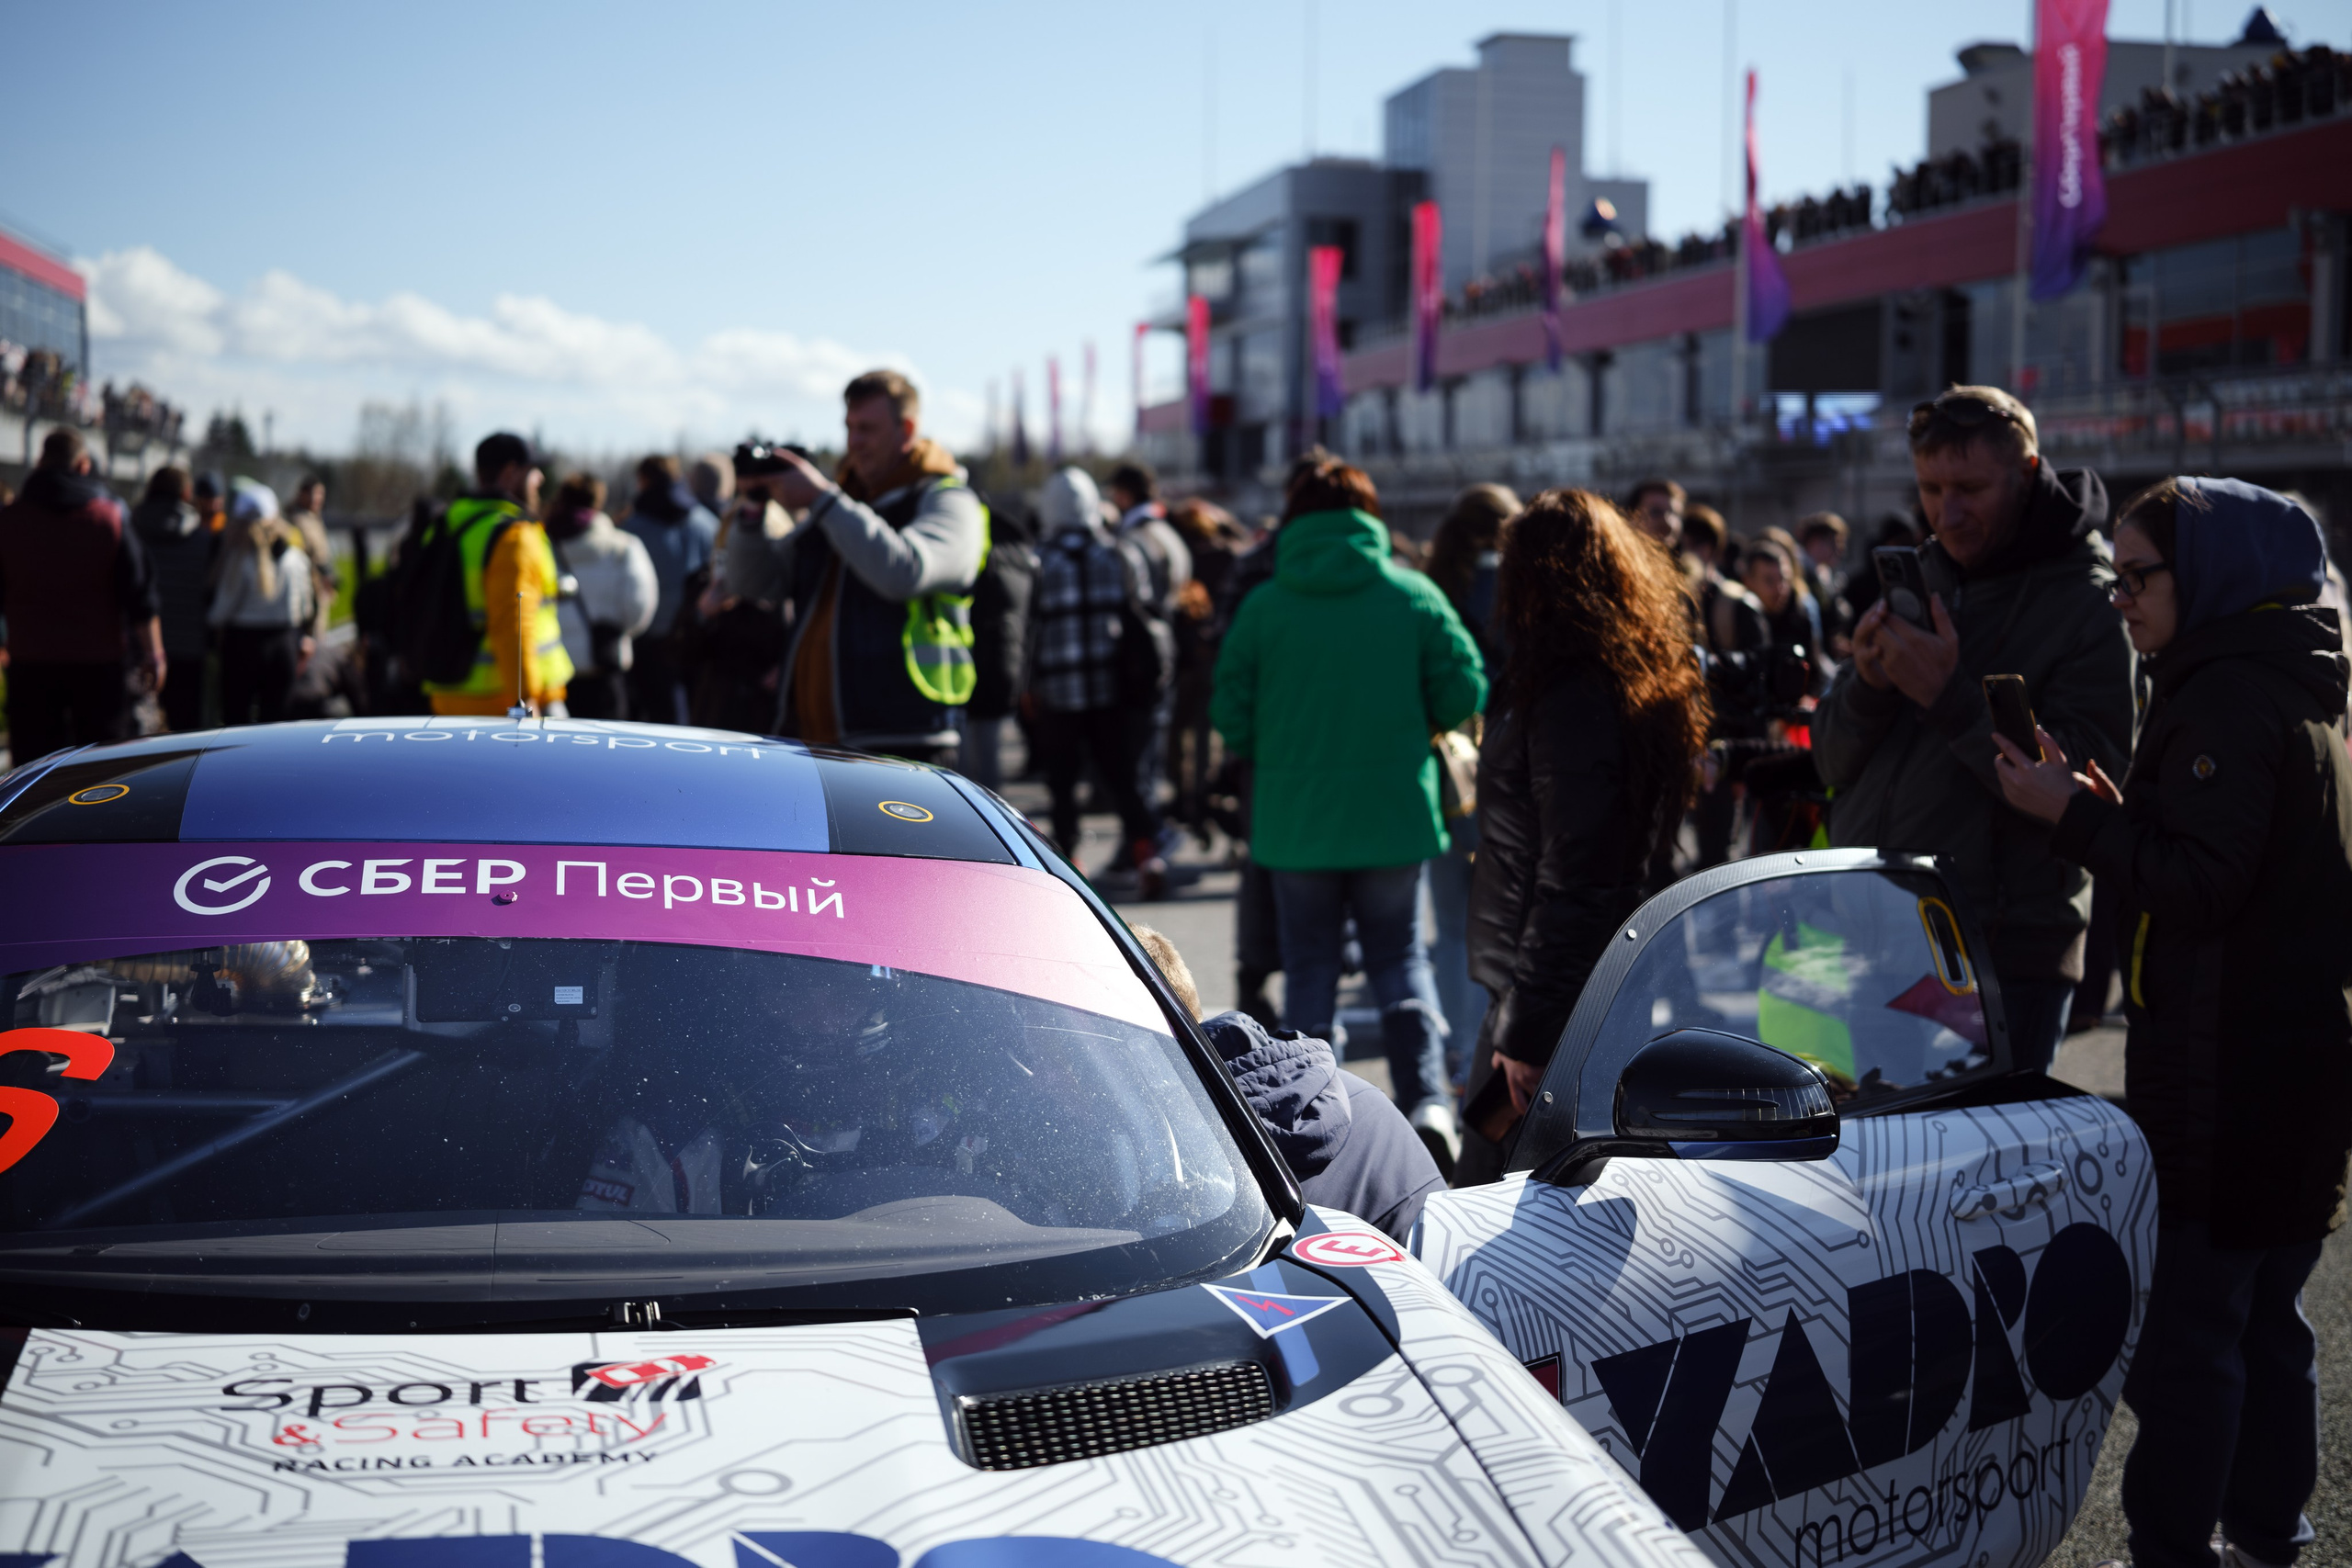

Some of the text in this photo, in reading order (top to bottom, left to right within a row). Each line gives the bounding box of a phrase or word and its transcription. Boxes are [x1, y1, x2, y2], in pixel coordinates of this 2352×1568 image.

[322, 728, 767, 760] motorsport
[299, 858, 846, 919] СБЕР Первый
[1317, 1240, 1385, 1258] E
[1590, 1223, 2132, 1533] YADRO
[220, 1379, 540, 1417] Sport
[274, 1450, 661, 1472] RACING ACADEMY
[1795, 1426, 2071, 1568] motorsport
